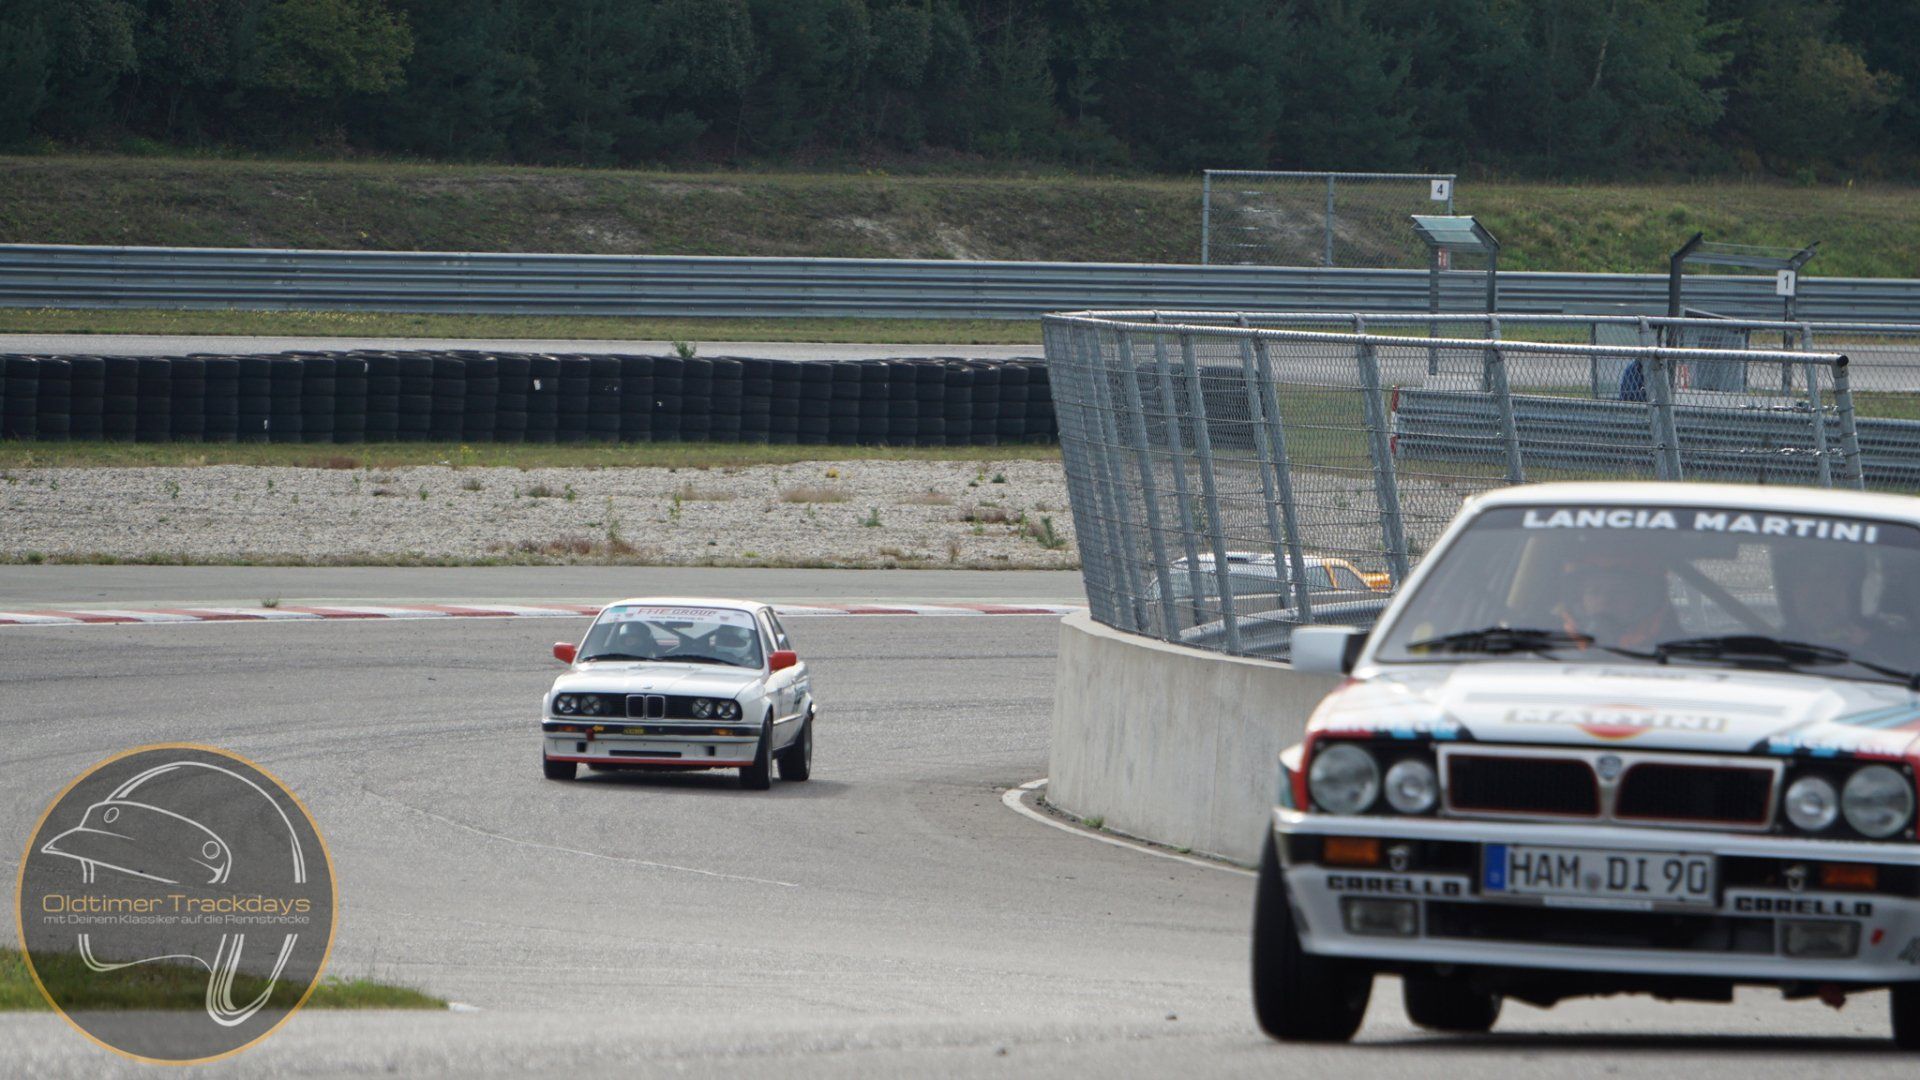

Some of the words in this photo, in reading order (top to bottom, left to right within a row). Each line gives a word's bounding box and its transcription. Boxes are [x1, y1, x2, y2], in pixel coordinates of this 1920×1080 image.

[1437, 184, 1443, 195] 4
[1522, 509, 1677, 529] LANCIA
[1693, 511, 1878, 544] MARTINI
[1505, 708, 1729, 732] MARTINI
[1327, 874, 1460, 895] CARELLO
[1509, 851, 1580, 889] HAM
[1606, 855, 1649, 892] DI
[1663, 859, 1707, 895] 90
[1735, 895, 1874, 917] CARELLO
